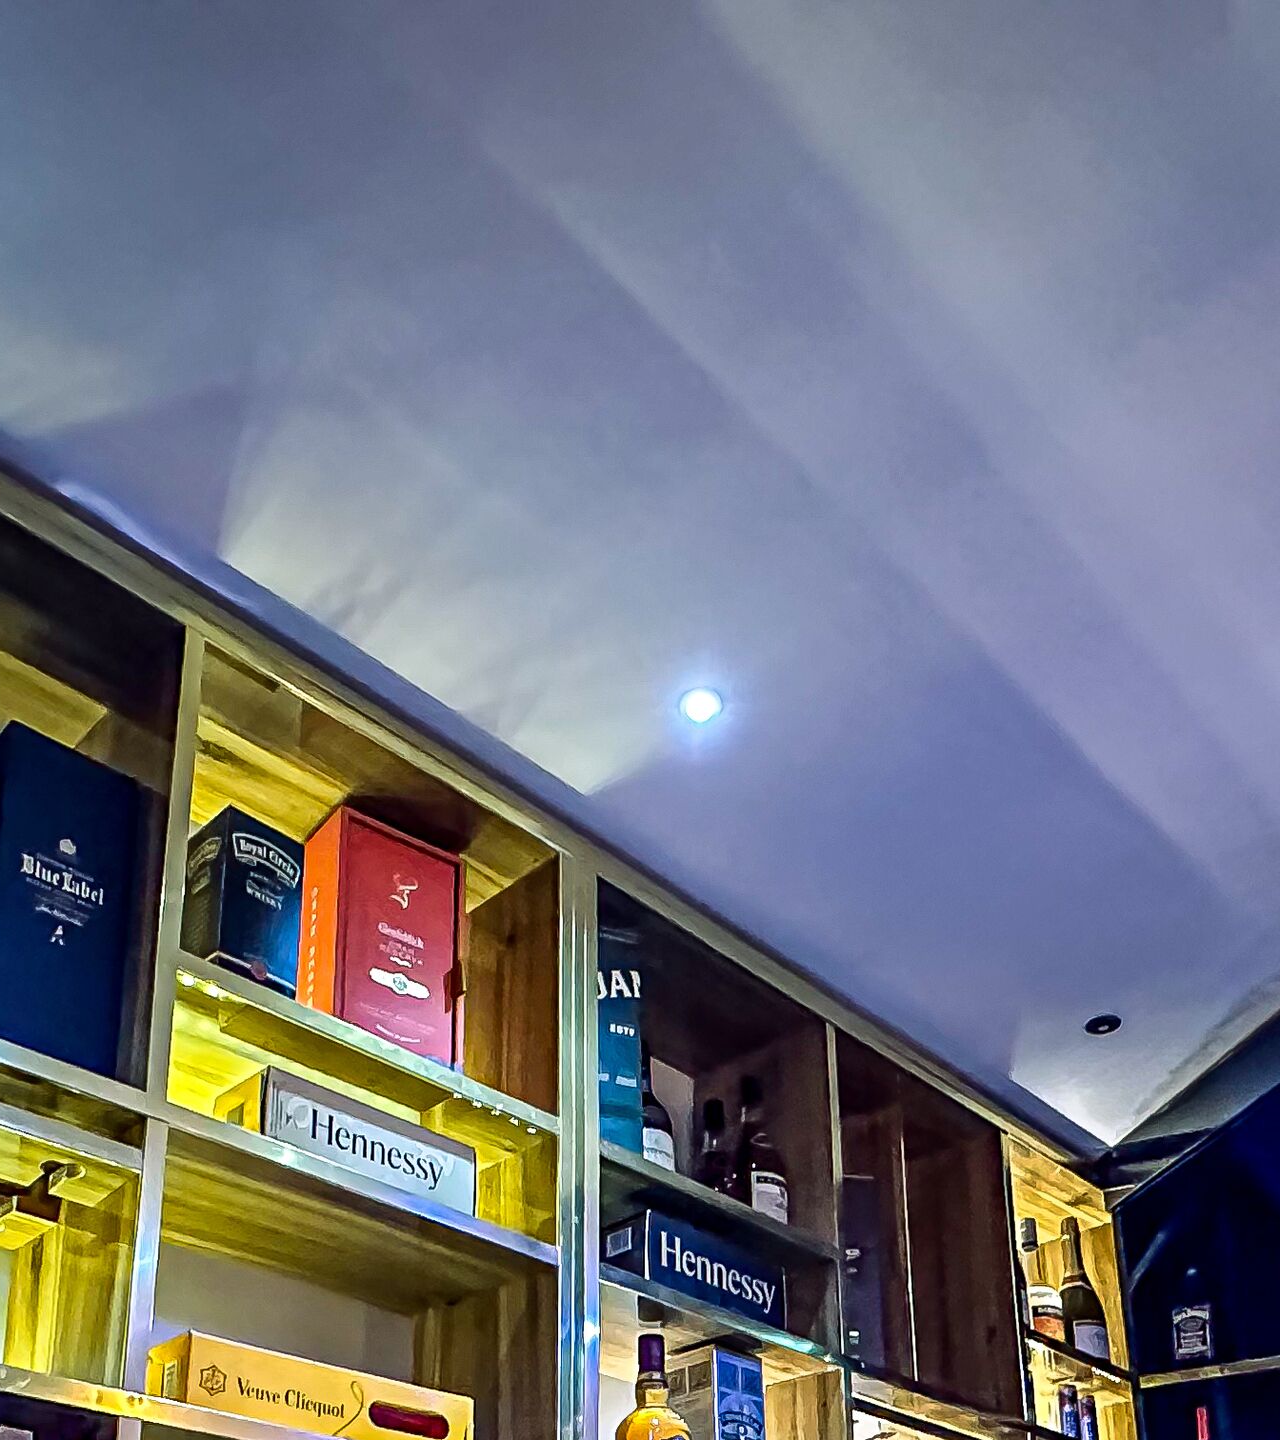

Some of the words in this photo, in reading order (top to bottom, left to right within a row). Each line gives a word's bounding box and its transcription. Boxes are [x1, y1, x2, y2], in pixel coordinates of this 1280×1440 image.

[20, 852, 60, 886] Blue
[61, 871, 104, 906] Label
[310, 1108, 444, 1191] Hennessy
[660, 1230, 776, 1314] Hennessy
[237, 1376, 281, 1405] Veuve
[284, 1388, 345, 1419] Clicquot
